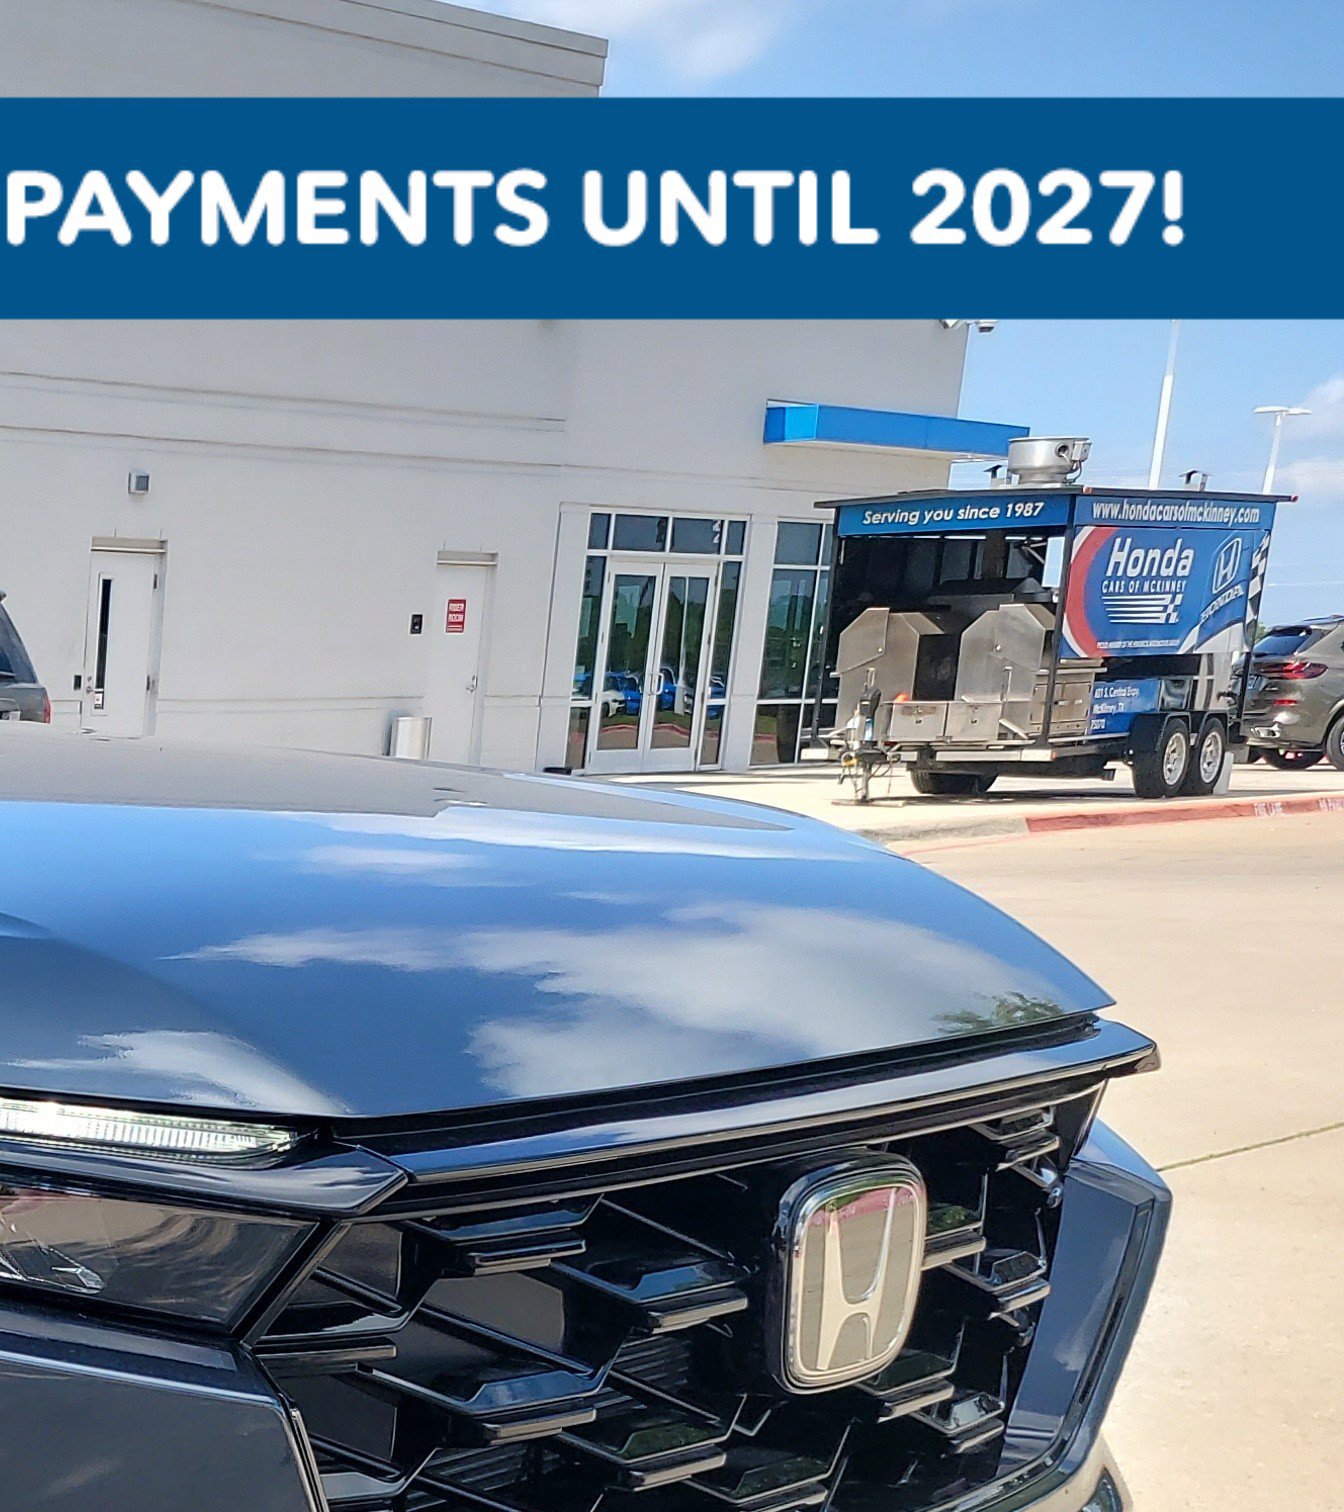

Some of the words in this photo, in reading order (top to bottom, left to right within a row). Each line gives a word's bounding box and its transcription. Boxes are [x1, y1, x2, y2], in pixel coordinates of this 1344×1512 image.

[862, 509, 919, 525] Serving
[923, 508, 953, 524] you
[957, 504, 999, 520] since
[1005, 502, 1044, 517] 1987
[1092, 499, 1260, 527] www.hondacarsofmckinney.com
[1105, 537, 1195, 577] Honda
[1102, 580, 1124, 593] CARS
[1128, 580, 1140, 593] OF
[1142, 580, 1187, 593] MCKINNEY
